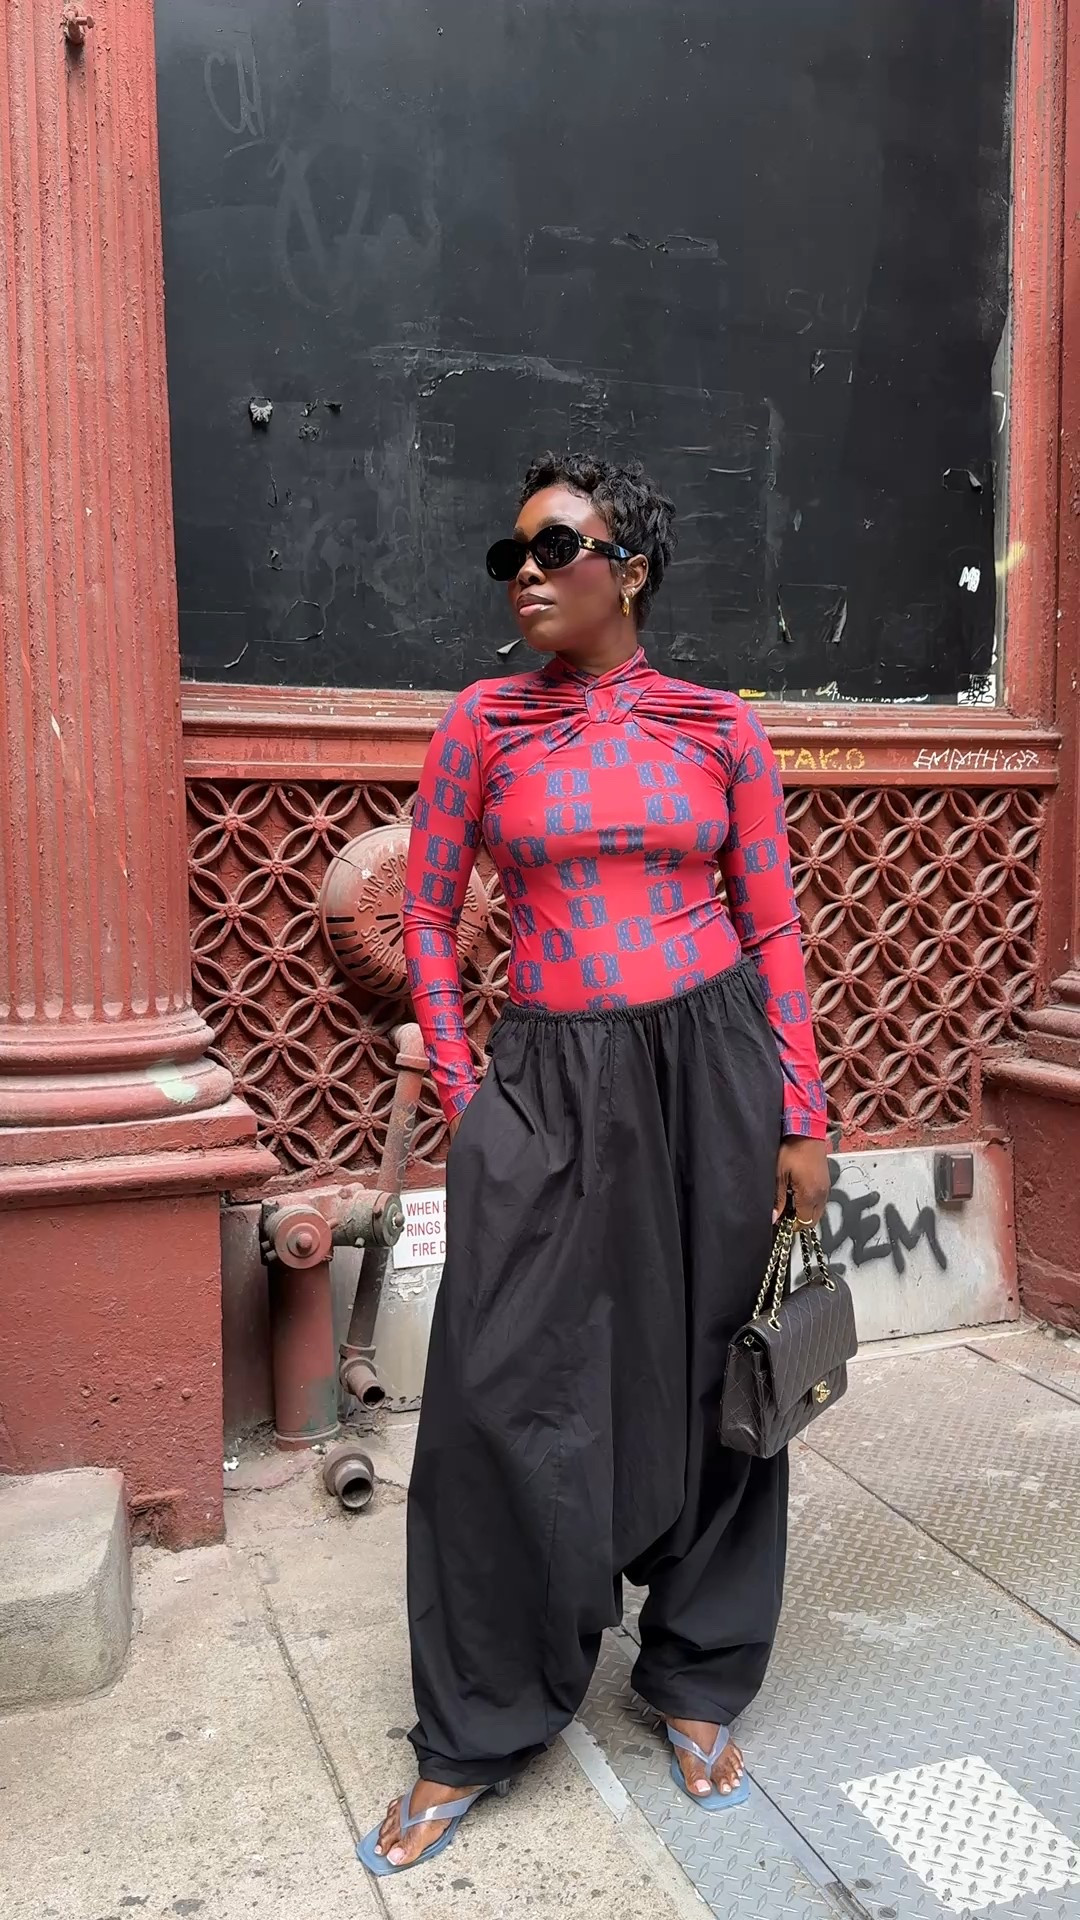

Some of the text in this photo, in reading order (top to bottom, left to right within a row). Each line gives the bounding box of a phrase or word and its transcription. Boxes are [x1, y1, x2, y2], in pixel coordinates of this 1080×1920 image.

[358, 874, 385, 914] STAR
[360, 925, 405, 970] SPRINK
[406, 1200, 440, 1217] WHEN
[406, 1220, 441, 1237] RINGS
[412, 1241, 437, 1257] FIRE
